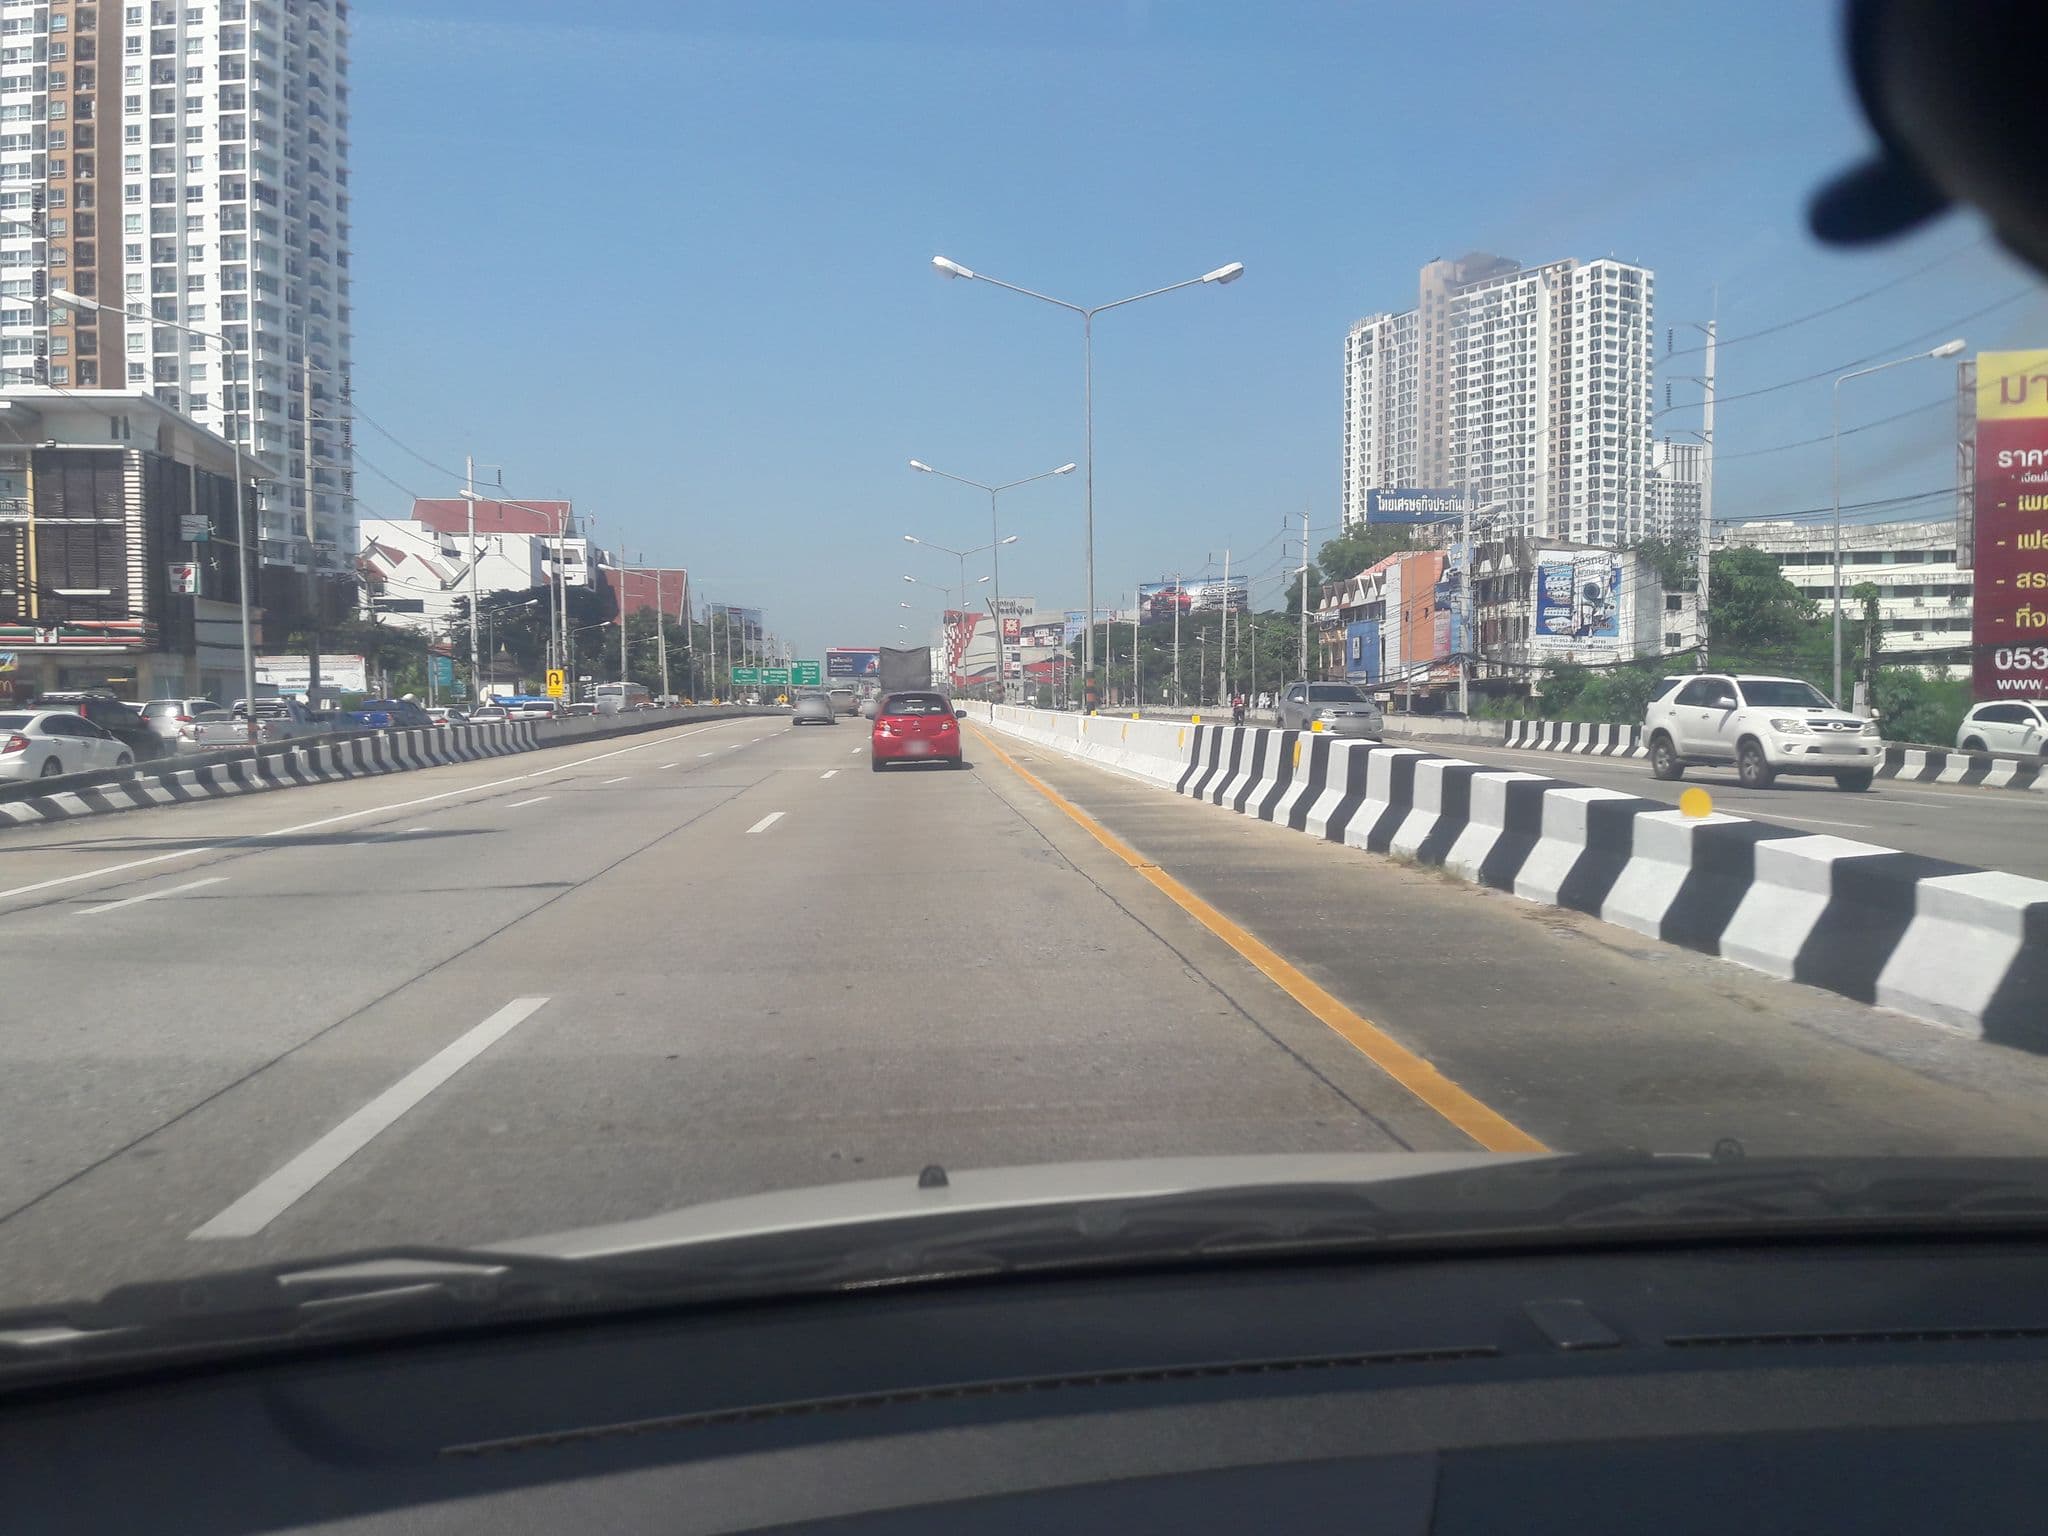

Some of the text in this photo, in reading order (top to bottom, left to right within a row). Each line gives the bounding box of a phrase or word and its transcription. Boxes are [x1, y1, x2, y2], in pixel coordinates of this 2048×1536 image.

[1376, 494, 1475, 516] ไทยเศรษฐกิจประกันย
[2016, 571, 2048, 589] สร
[997, 605, 1033, 617] estival
[2015, 602, 2048, 628] ที่จ
[1995, 646, 2048, 670] 053
